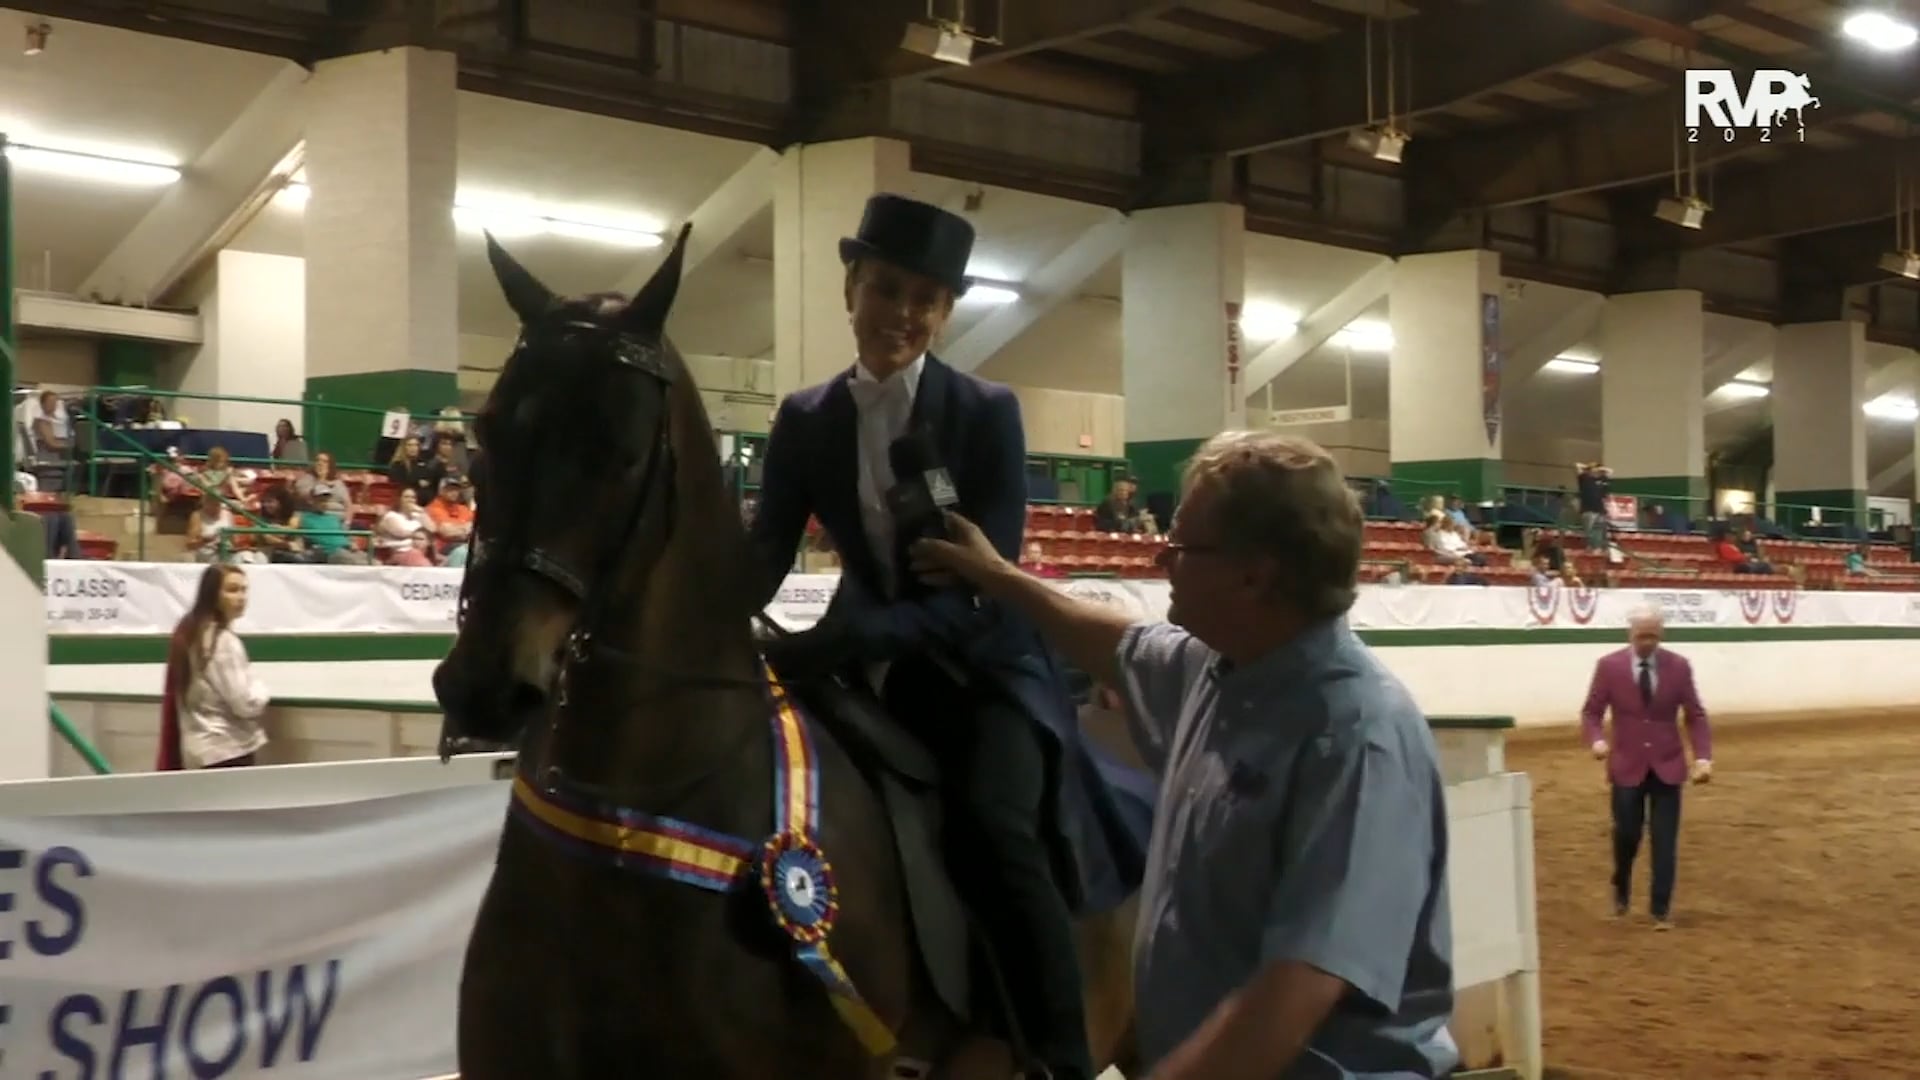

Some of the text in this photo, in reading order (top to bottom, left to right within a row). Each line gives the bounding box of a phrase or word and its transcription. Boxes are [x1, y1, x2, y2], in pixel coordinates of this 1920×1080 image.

[1225, 302, 1240, 384] WEST
[390, 419, 400, 435] 9
[52, 578, 127, 598] CLASSIC
[37, 959, 341, 1080] SHOW
